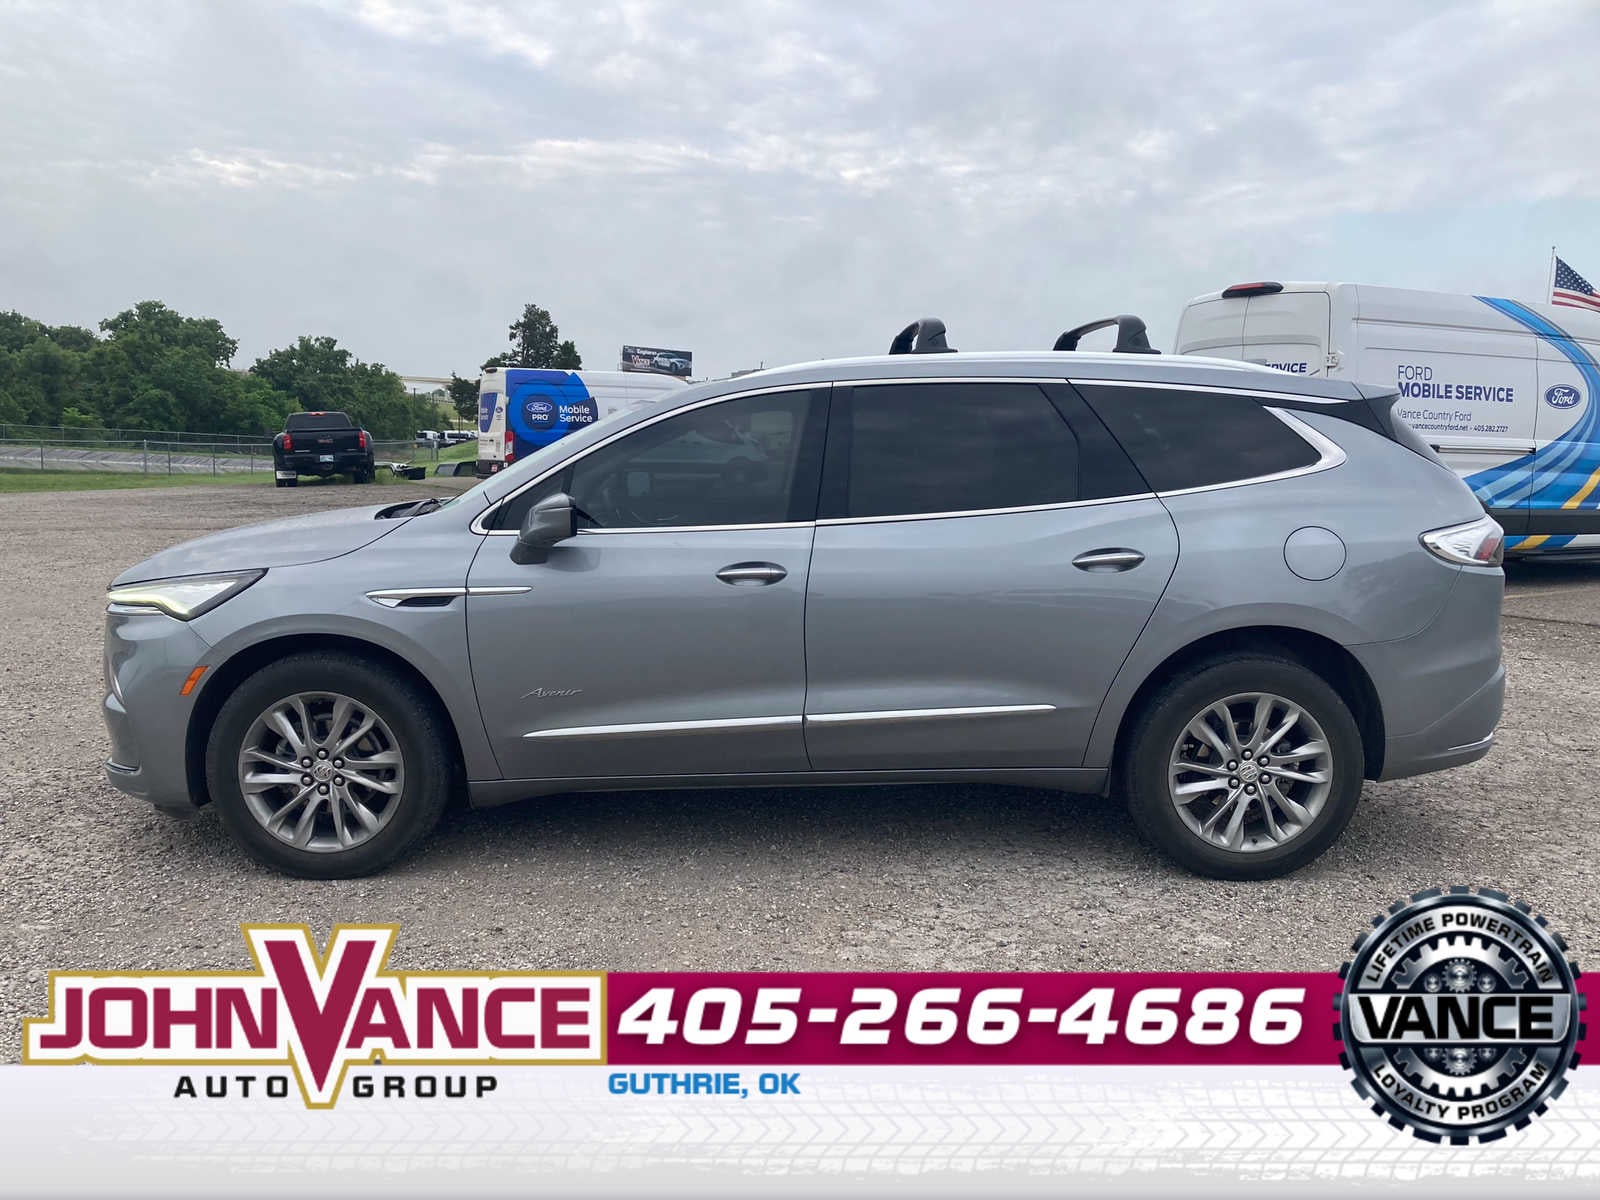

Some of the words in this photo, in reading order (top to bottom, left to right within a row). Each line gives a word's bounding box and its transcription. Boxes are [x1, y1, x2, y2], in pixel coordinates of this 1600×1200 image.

[1398, 365, 1433, 381] FORD
[1398, 382, 1453, 400] MOBILE
[1455, 385, 1514, 403] SERVICE
[559, 405, 590, 414] Mobile
[531, 413, 549, 421] PRO
[559, 414, 593, 423] Service
[1422, 410, 1453, 422] Country
[1454, 411, 1472, 421] Ford
[1409, 423, 1468, 432] vancecountryford.net
